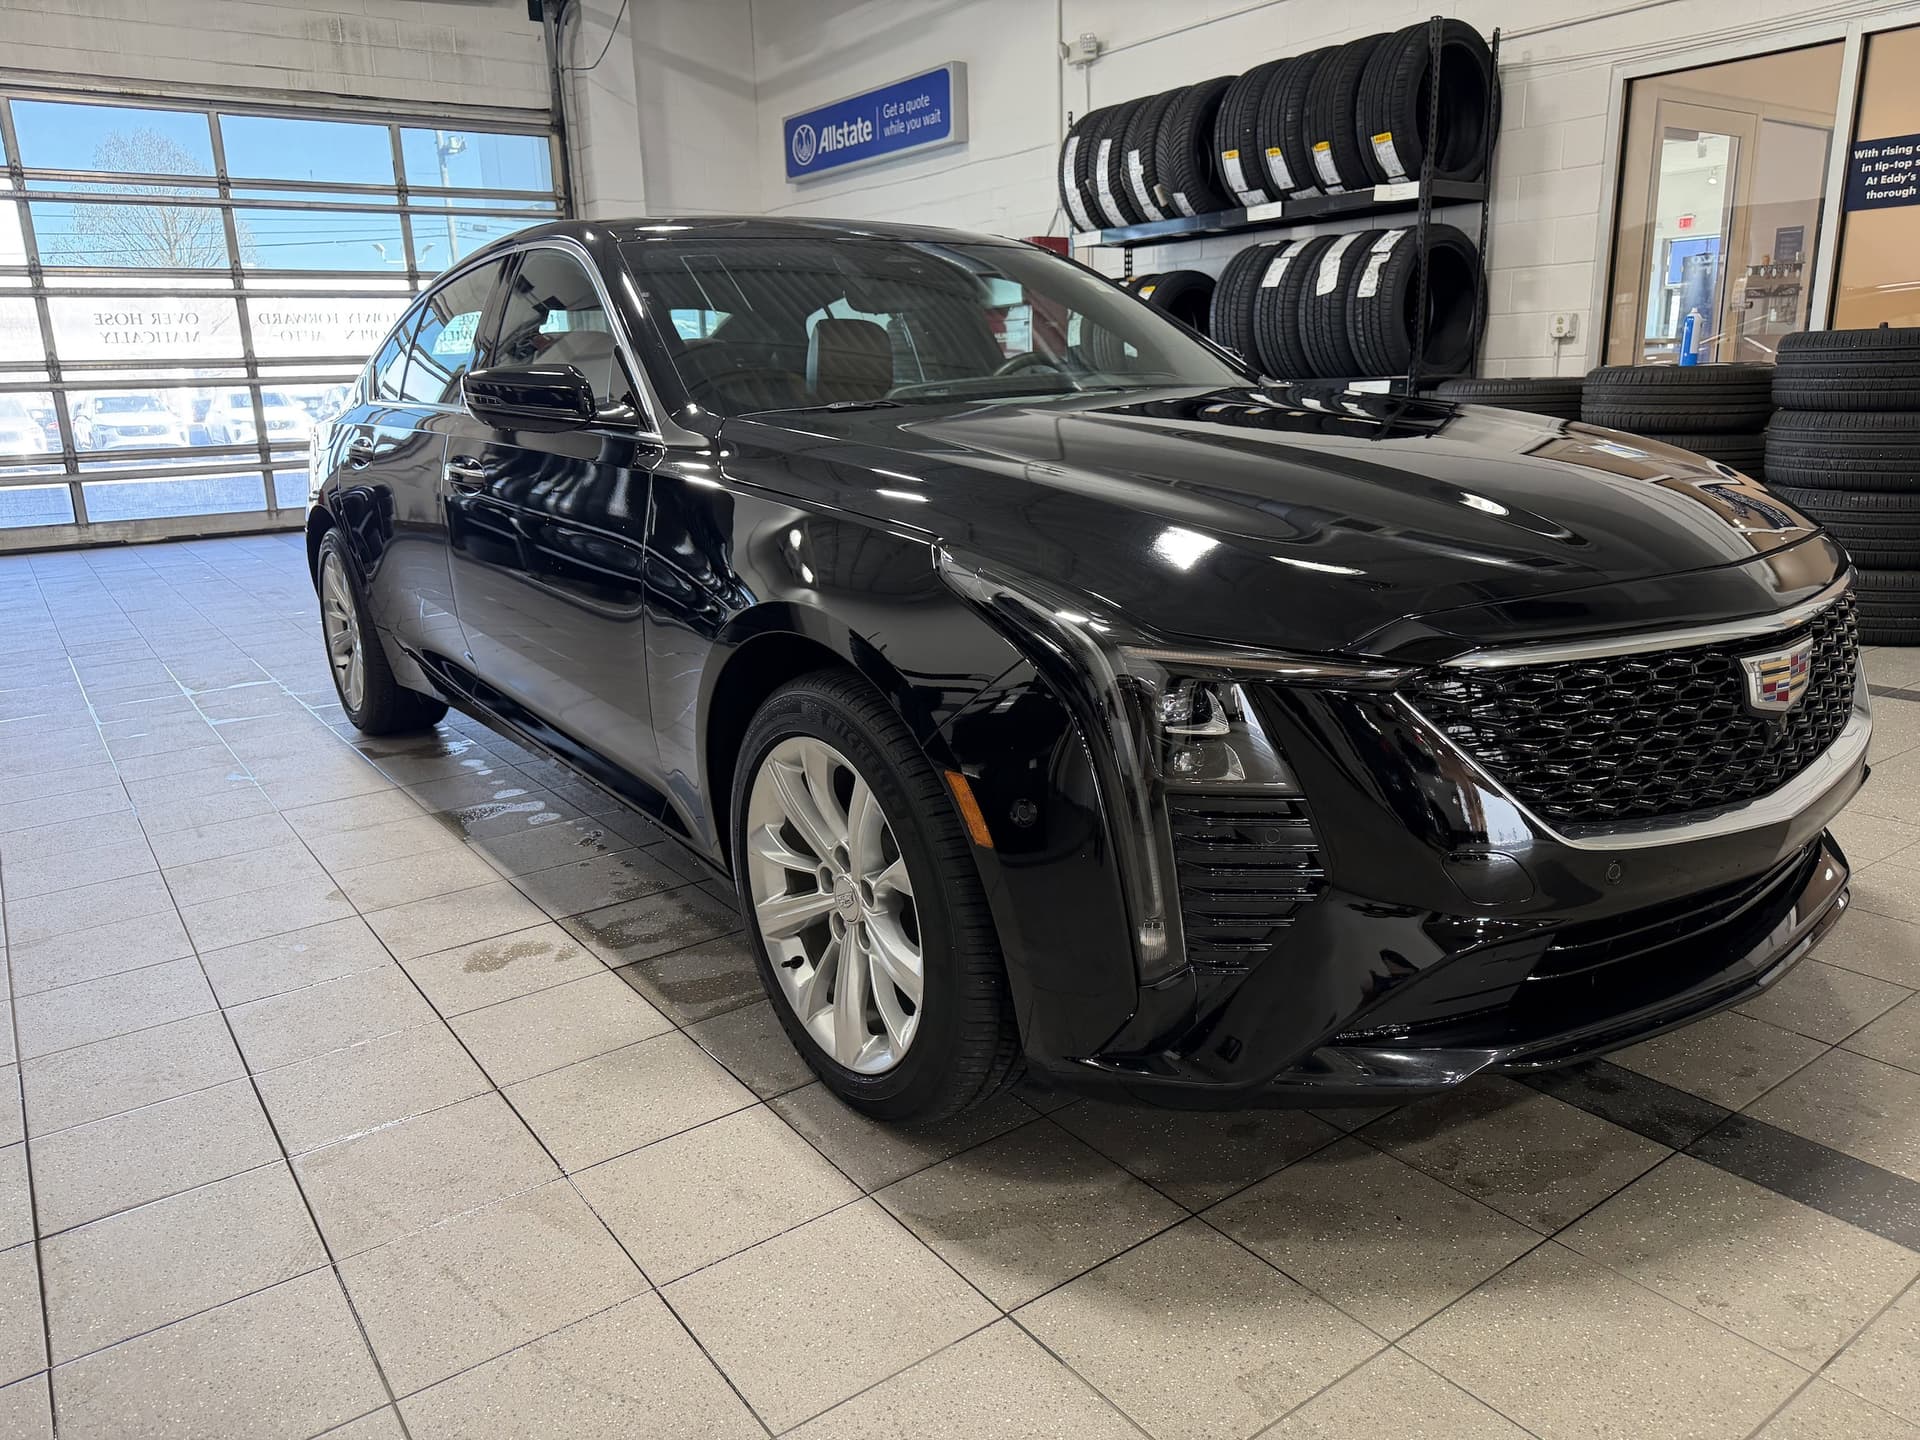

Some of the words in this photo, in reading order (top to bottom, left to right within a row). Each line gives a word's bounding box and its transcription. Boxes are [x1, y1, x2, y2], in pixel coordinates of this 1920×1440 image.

[882, 103, 898, 119] Get
[898, 103, 905, 114] a
[905, 93, 930, 113] quote
[883, 120, 906, 137] while
[906, 116, 922, 135] you
[922, 109, 941, 125] wait
[818, 117, 873, 154] Allstate
[1854, 148, 1879, 159] With
[1881, 145, 1913, 157] rising
[1861, 163, 1872, 172] in
[1875, 160, 1912, 172] tip-top
[1865, 176, 1878, 186] At
[1880, 172, 1917, 184] Eddy's
[1866, 186, 1917, 200] thorough
